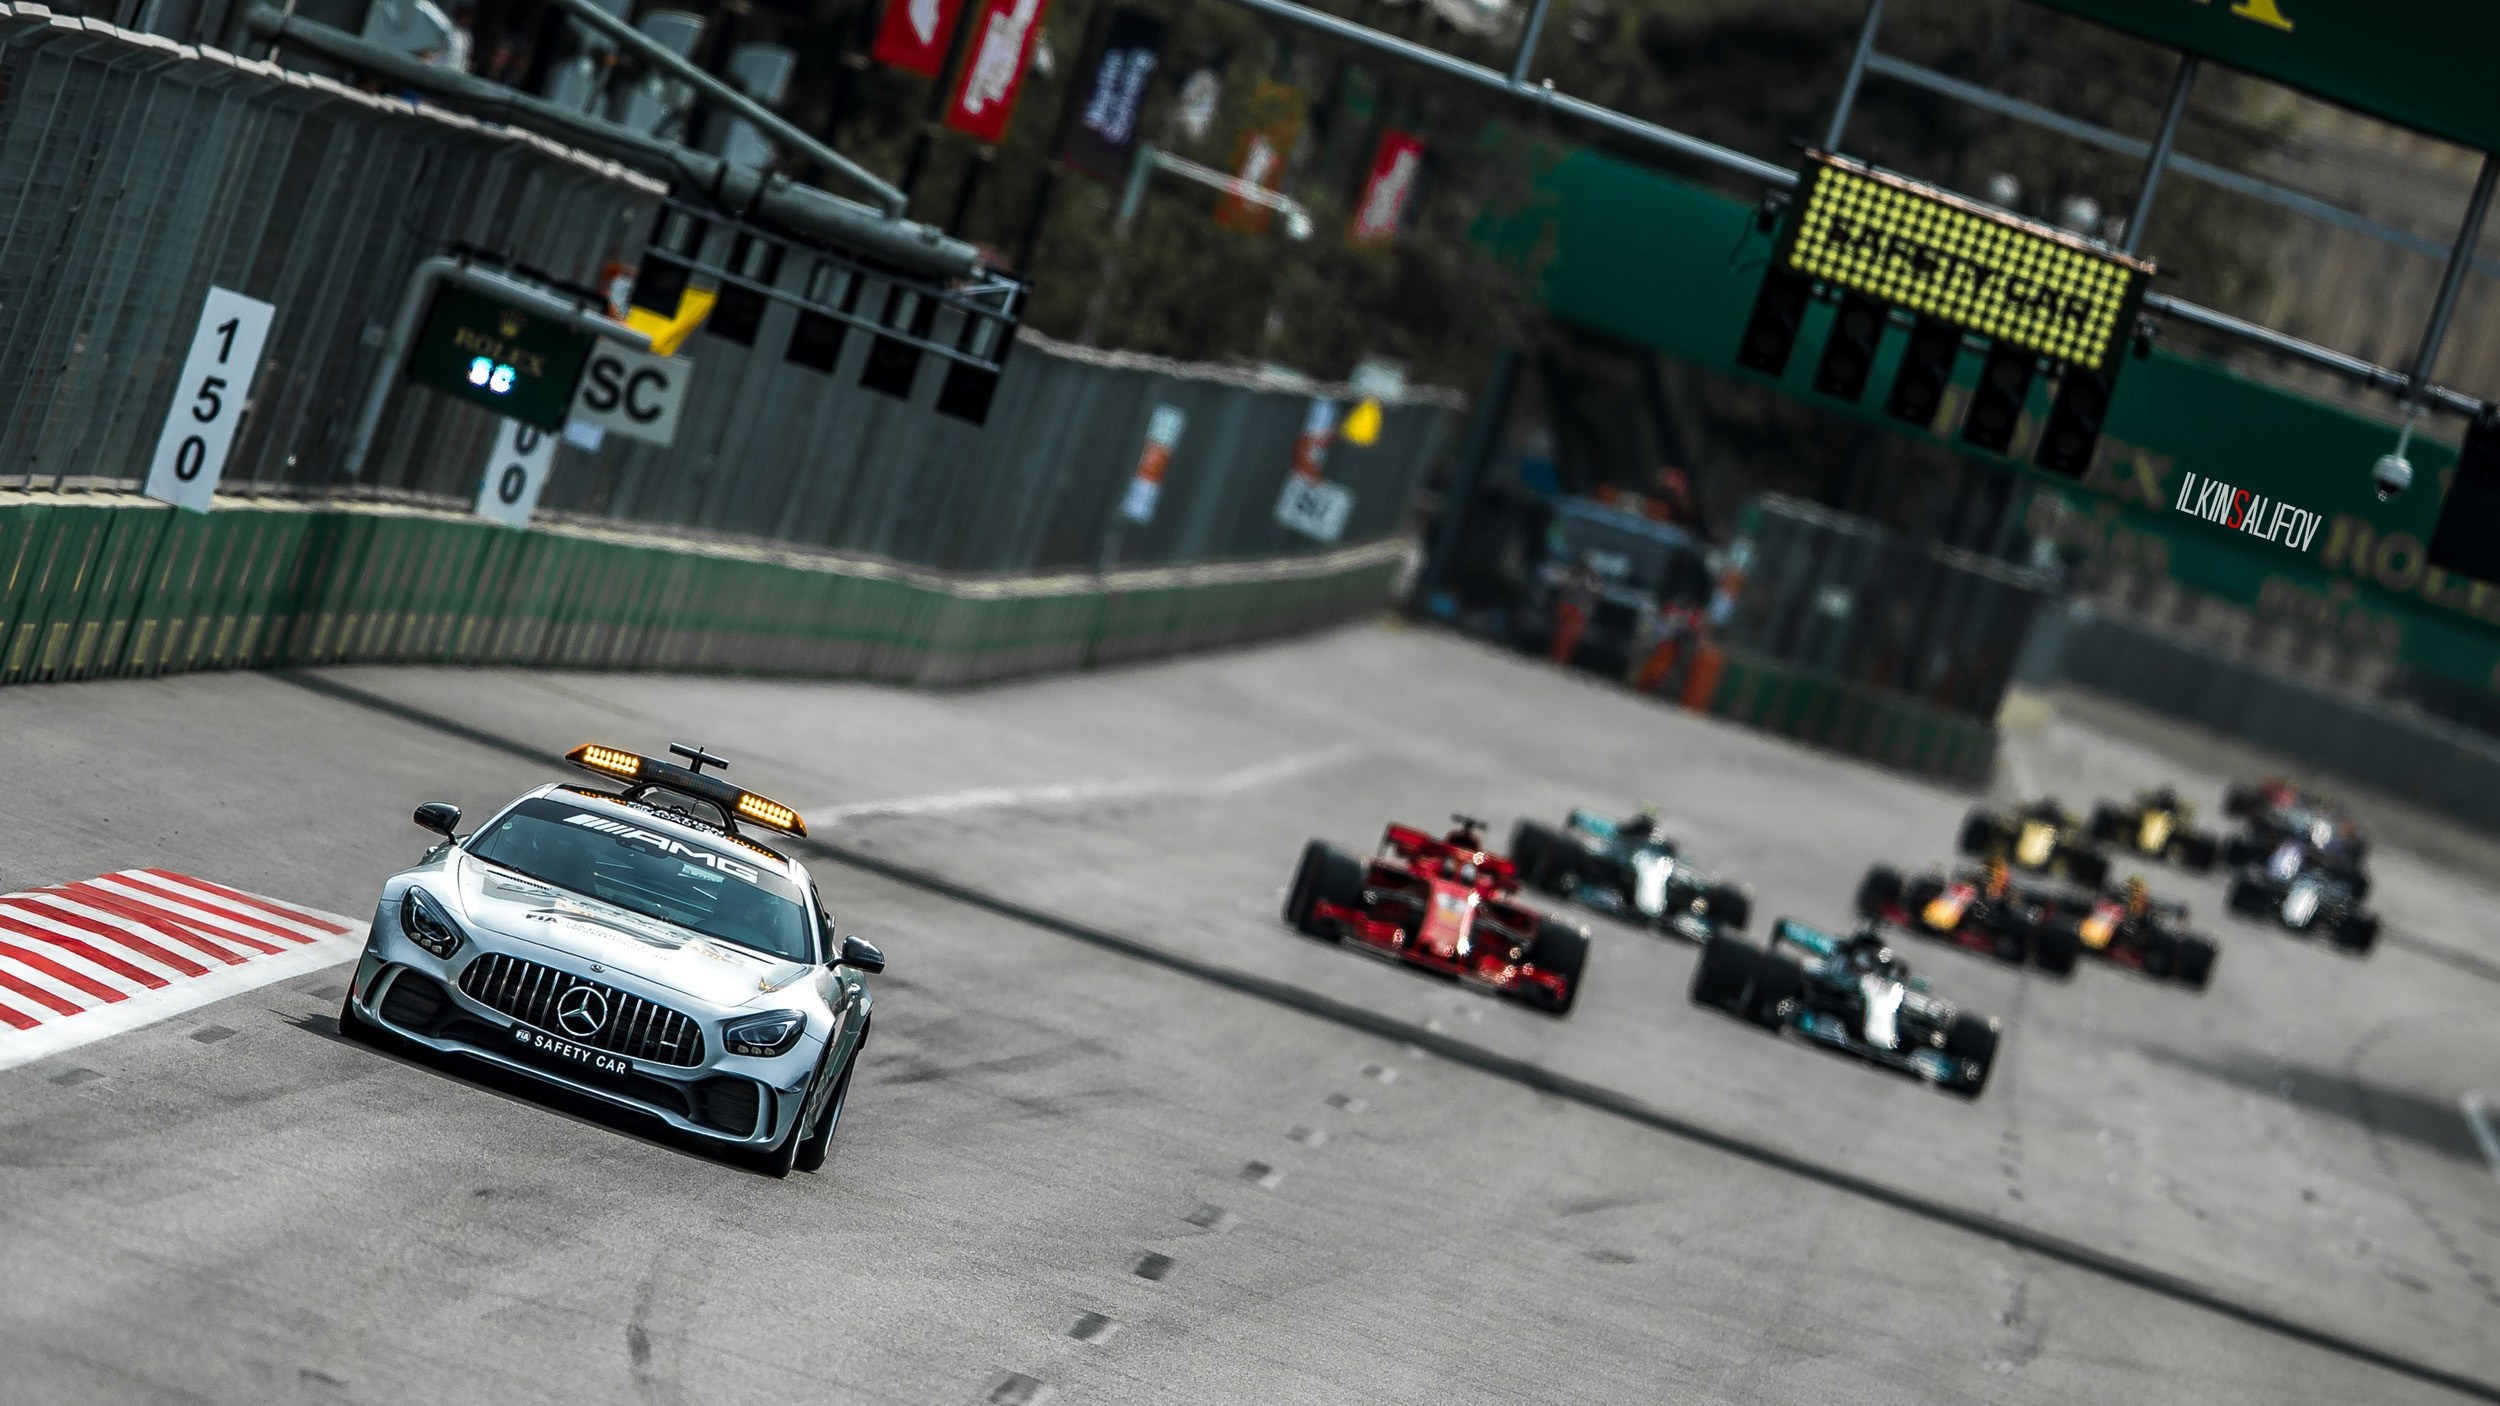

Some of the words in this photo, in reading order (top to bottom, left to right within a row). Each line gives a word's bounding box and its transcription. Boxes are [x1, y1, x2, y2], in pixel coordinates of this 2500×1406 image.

[2002, 275, 2093, 329] CAR
[174, 317, 241, 482] 150
[583, 354, 670, 425] SC
[627, 831, 760, 884] AMG
[515, 1028, 532, 1043] FIA
[534, 1035, 592, 1063] SAFETY
[595, 1055, 627, 1074] CAR
